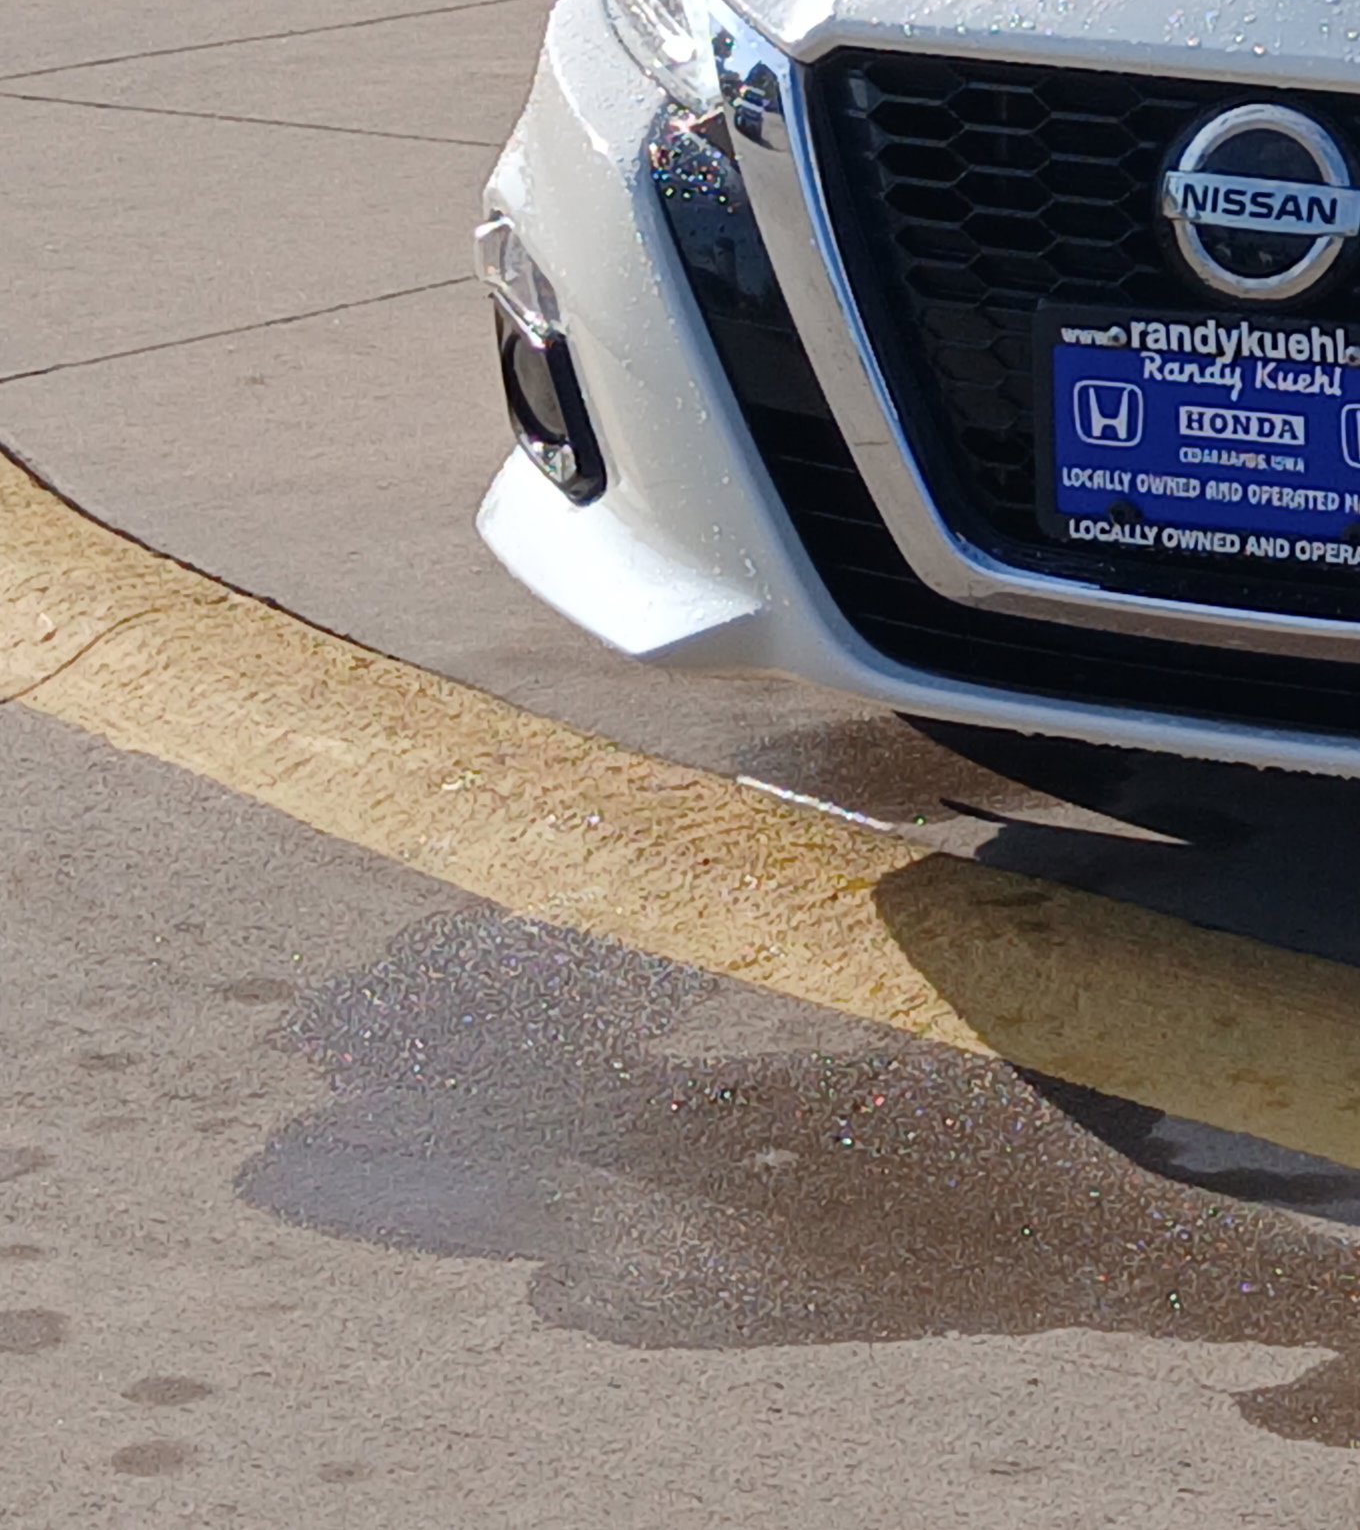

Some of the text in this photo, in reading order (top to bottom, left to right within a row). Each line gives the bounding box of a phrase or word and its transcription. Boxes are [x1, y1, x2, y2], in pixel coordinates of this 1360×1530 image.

[1182, 182, 1338, 225] NISSAN
[1139, 351, 1343, 402] Randy Kuehl
[1184, 409, 1301, 441] HONDA
[1062, 466, 1132, 495] LOCALLY
[1136, 473, 1201, 499] OWNED
[1205, 480, 1243, 503] AND
[1247, 483, 1341, 512] OPERATED
[1069, 518, 1158, 546] LOCALLY
[1161, 527, 1241, 554] OWNED
[1244, 534, 1290, 559] AND
